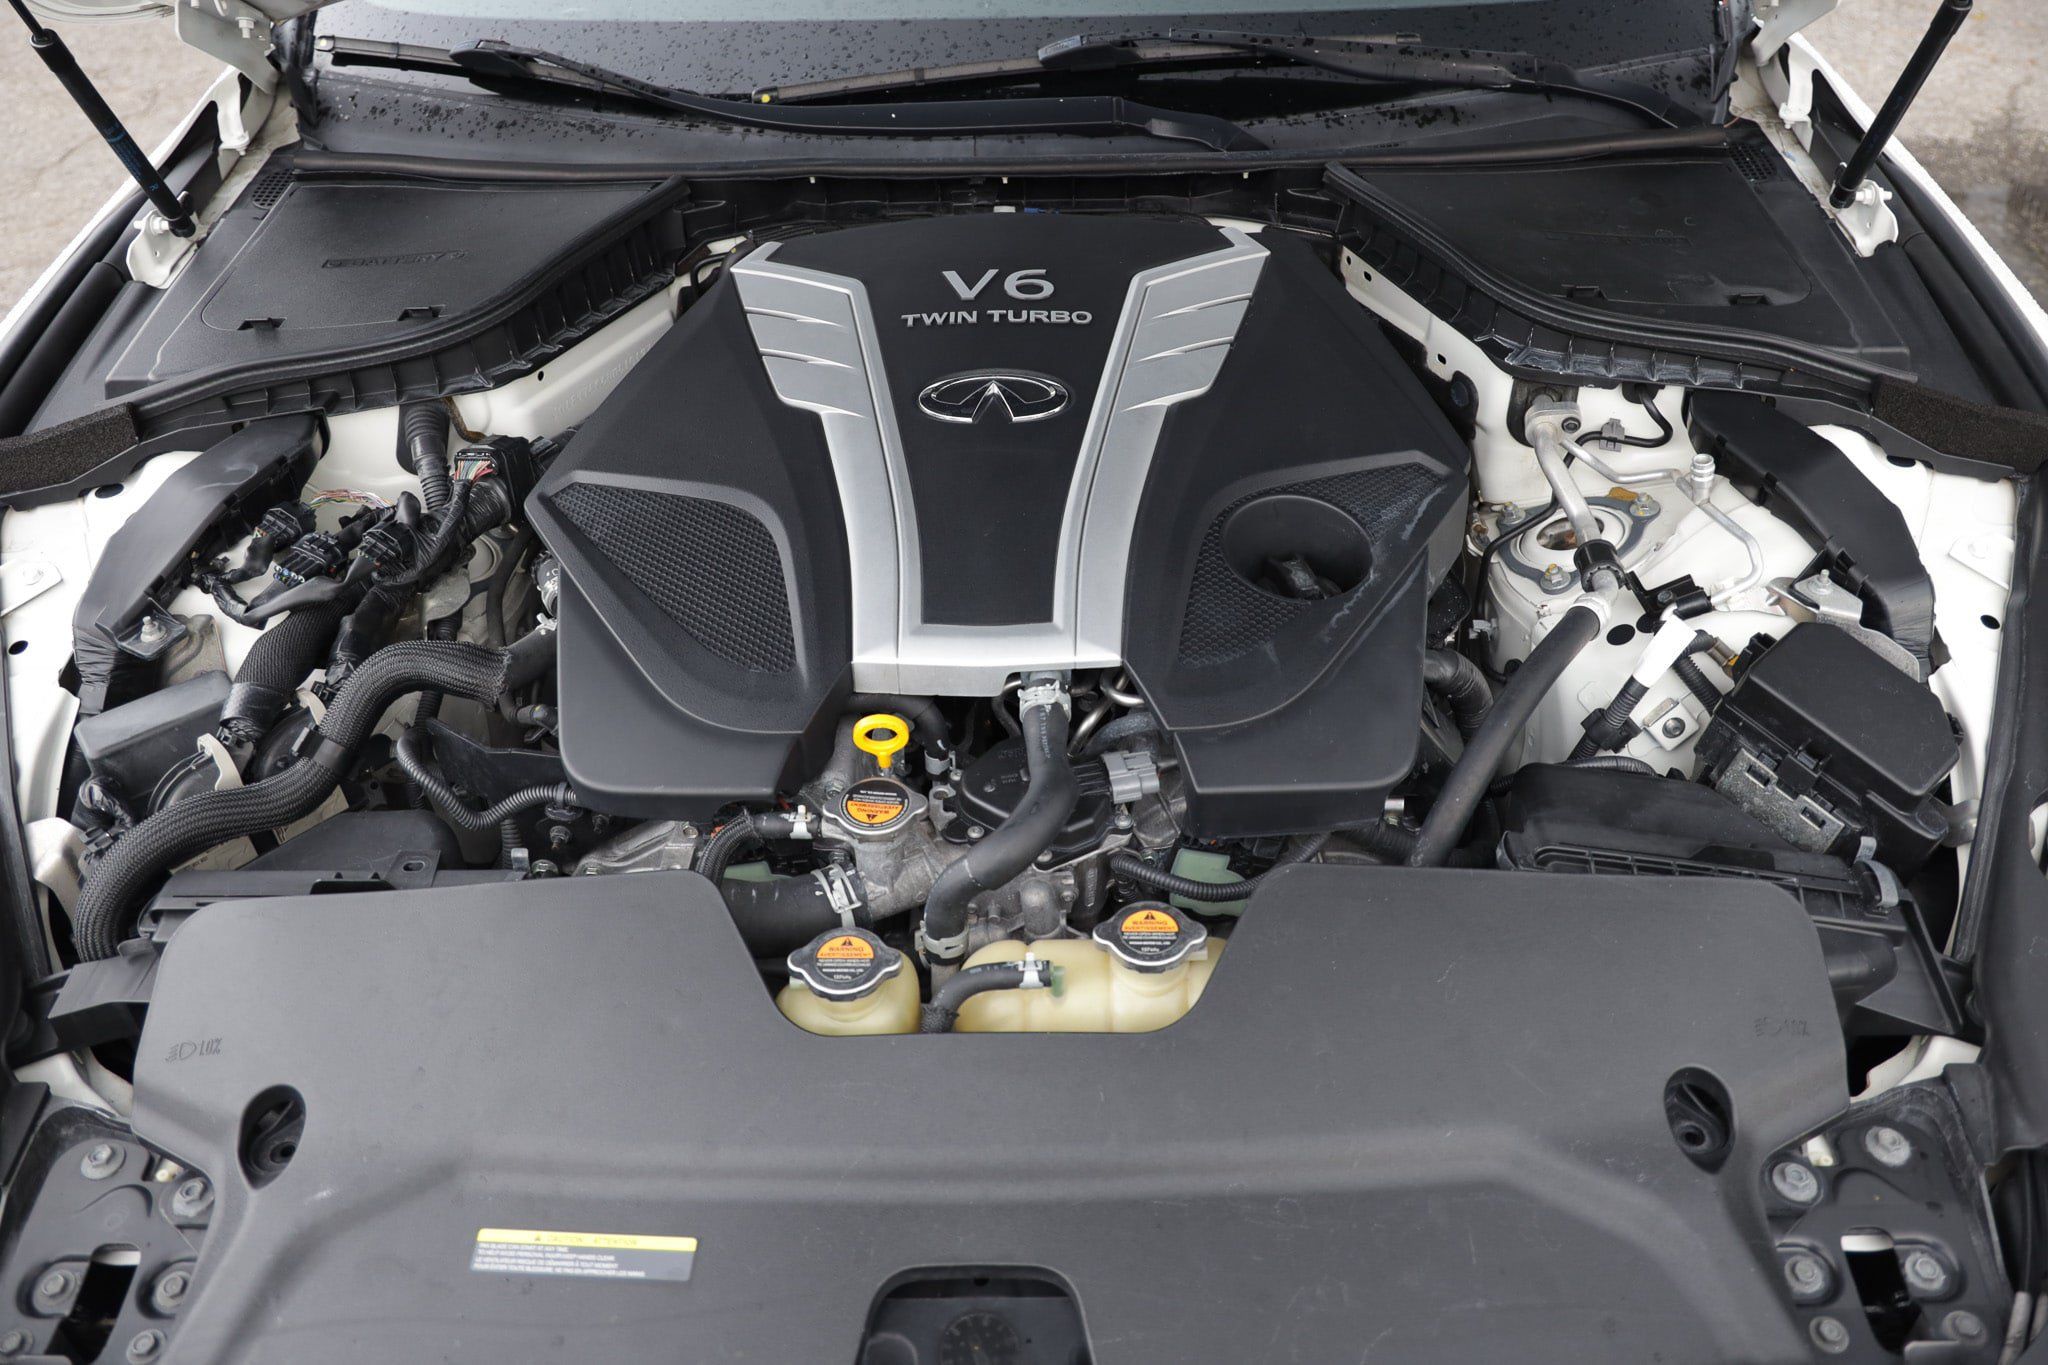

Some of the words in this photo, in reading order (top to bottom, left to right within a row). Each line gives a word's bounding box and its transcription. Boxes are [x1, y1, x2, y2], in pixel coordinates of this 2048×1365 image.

[941, 268, 1055, 301] V6
[901, 310, 978, 328] TWIN
[986, 309, 1093, 325] TURBO
